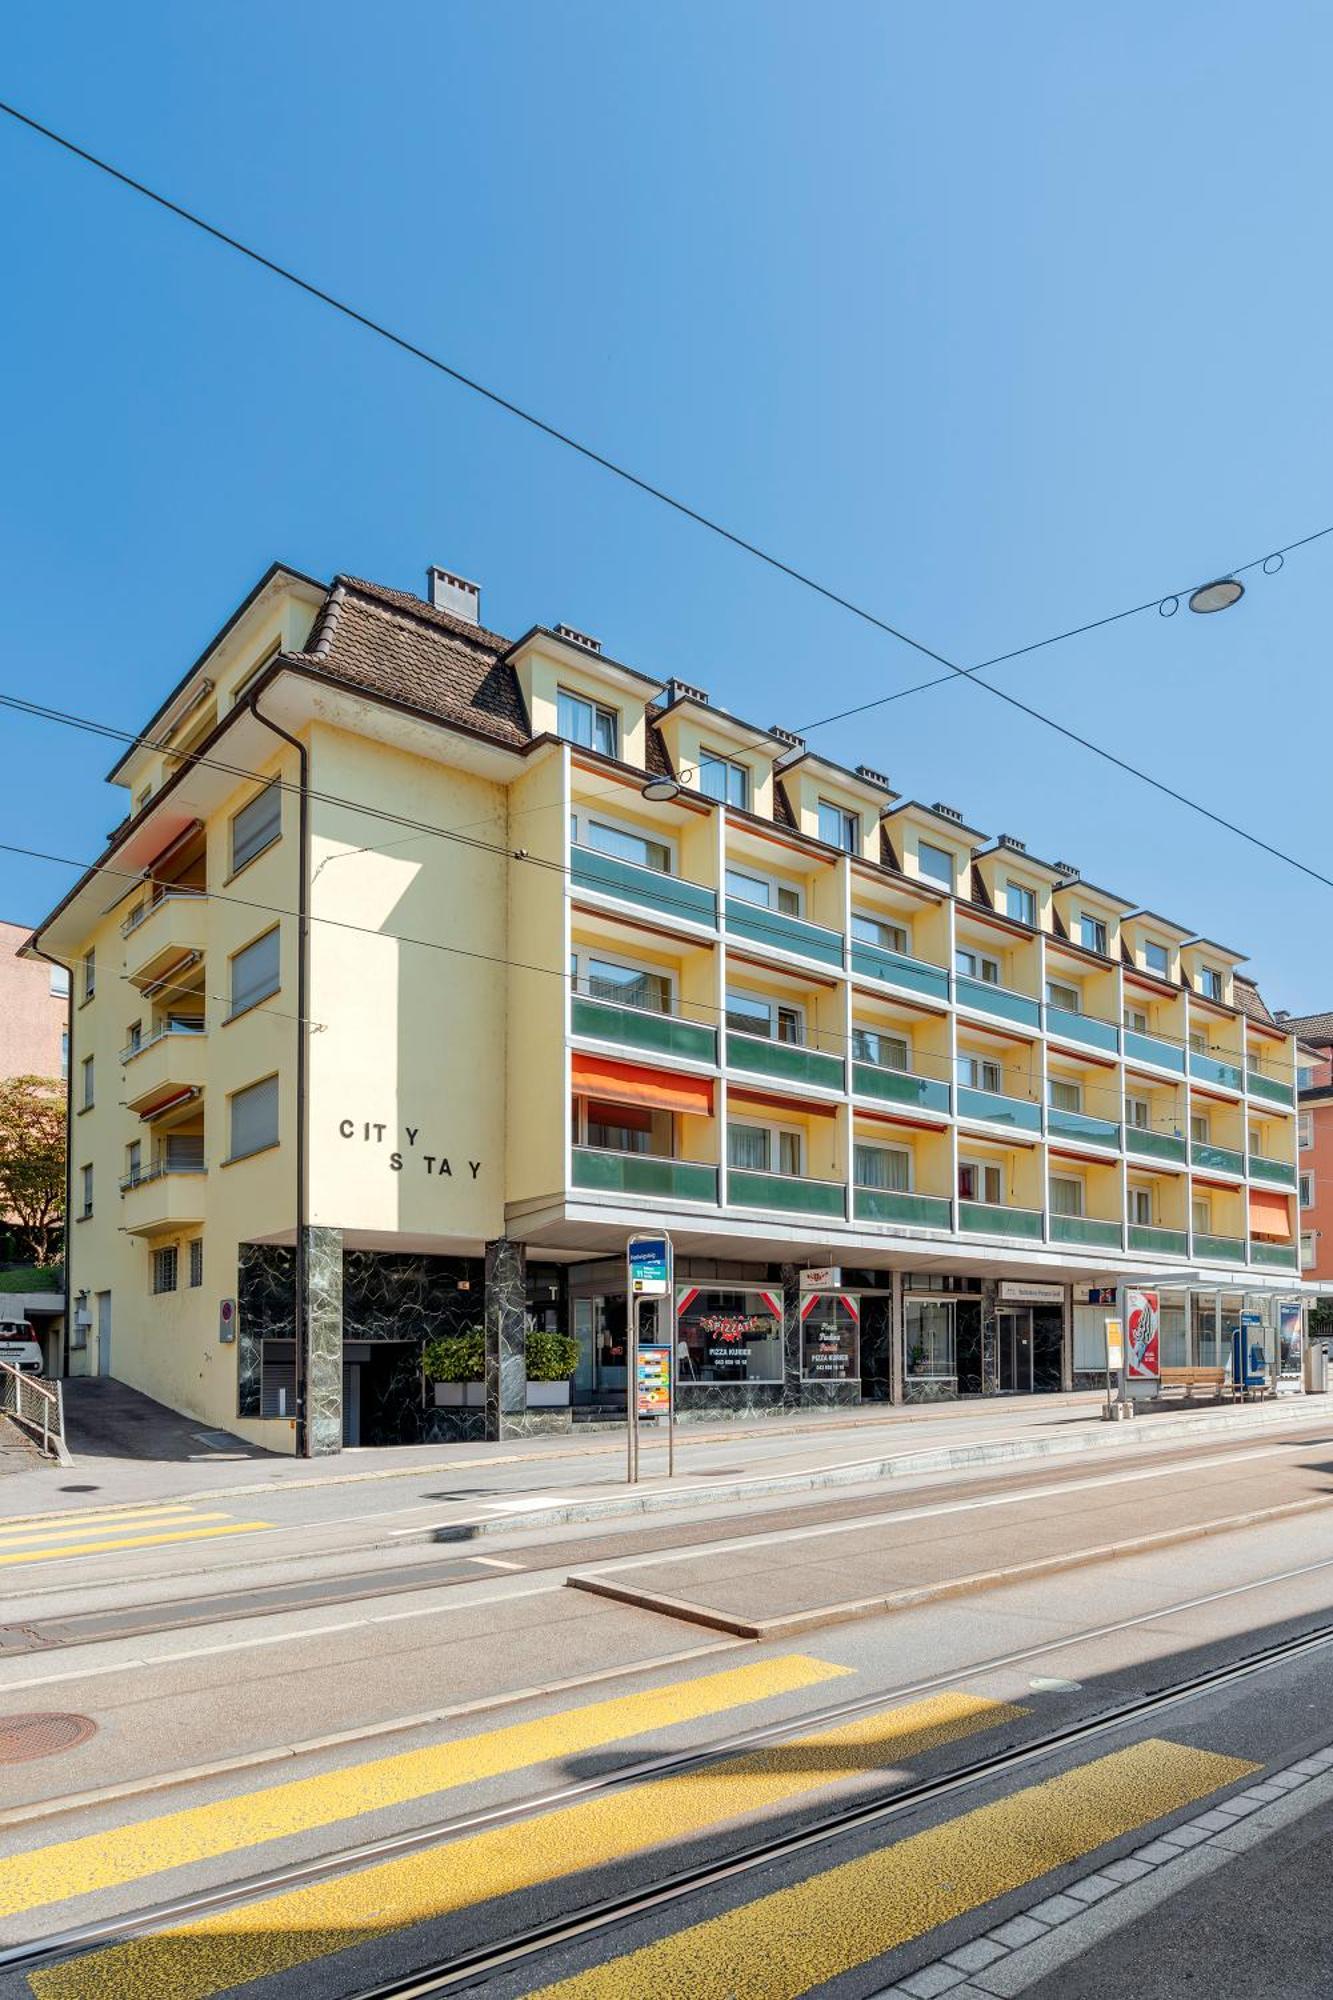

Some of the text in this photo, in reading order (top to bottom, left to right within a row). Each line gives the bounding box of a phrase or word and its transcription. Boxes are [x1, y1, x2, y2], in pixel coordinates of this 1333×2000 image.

[339, 1119, 419, 1146] CITY
[389, 1152, 481, 1179] STAY
[709, 1348, 728, 1356] PIZZA
